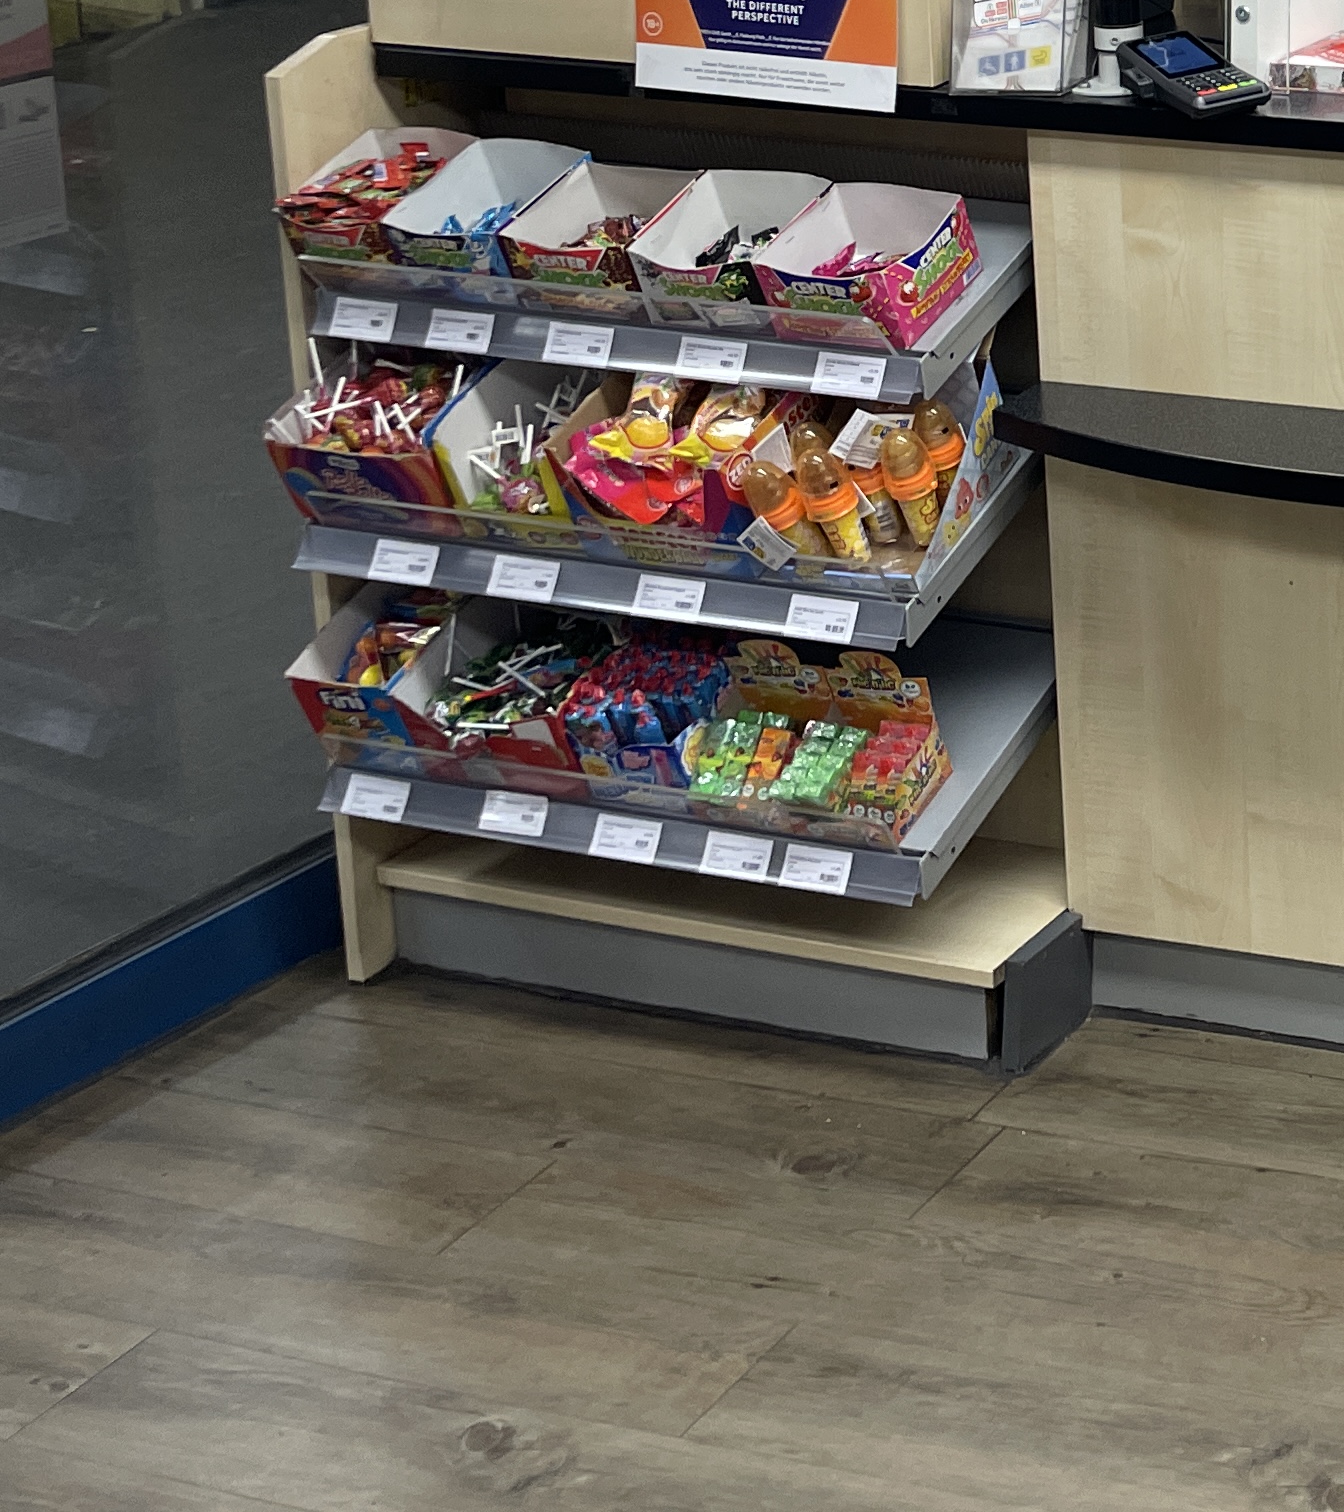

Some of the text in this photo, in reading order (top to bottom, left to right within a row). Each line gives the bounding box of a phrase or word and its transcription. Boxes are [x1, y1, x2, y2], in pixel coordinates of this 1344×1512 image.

[726, 0, 804, 16] THE DIFFERENT
[731, 10, 799, 25] PERSPECTIVE
[318, 690, 368, 711] Fini
